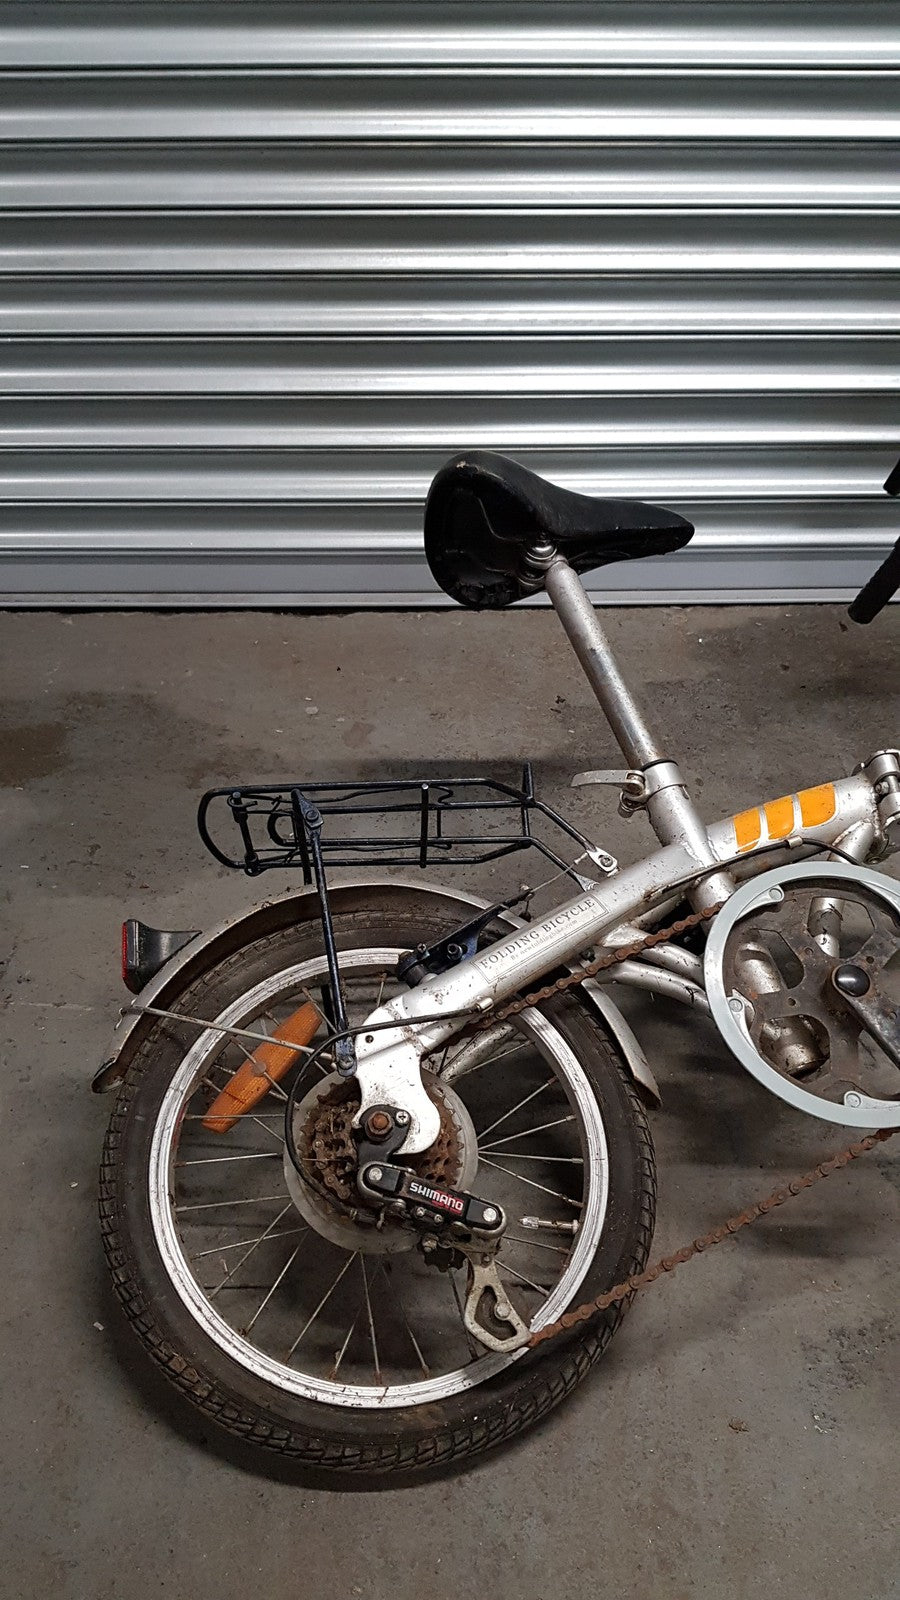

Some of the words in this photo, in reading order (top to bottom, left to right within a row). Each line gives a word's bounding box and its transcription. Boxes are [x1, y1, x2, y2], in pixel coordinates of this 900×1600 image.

[480, 930, 540, 968] FOLDING
[541, 899, 595, 932] BICYCLE
[410, 1182, 464, 1211] SHIMANO
